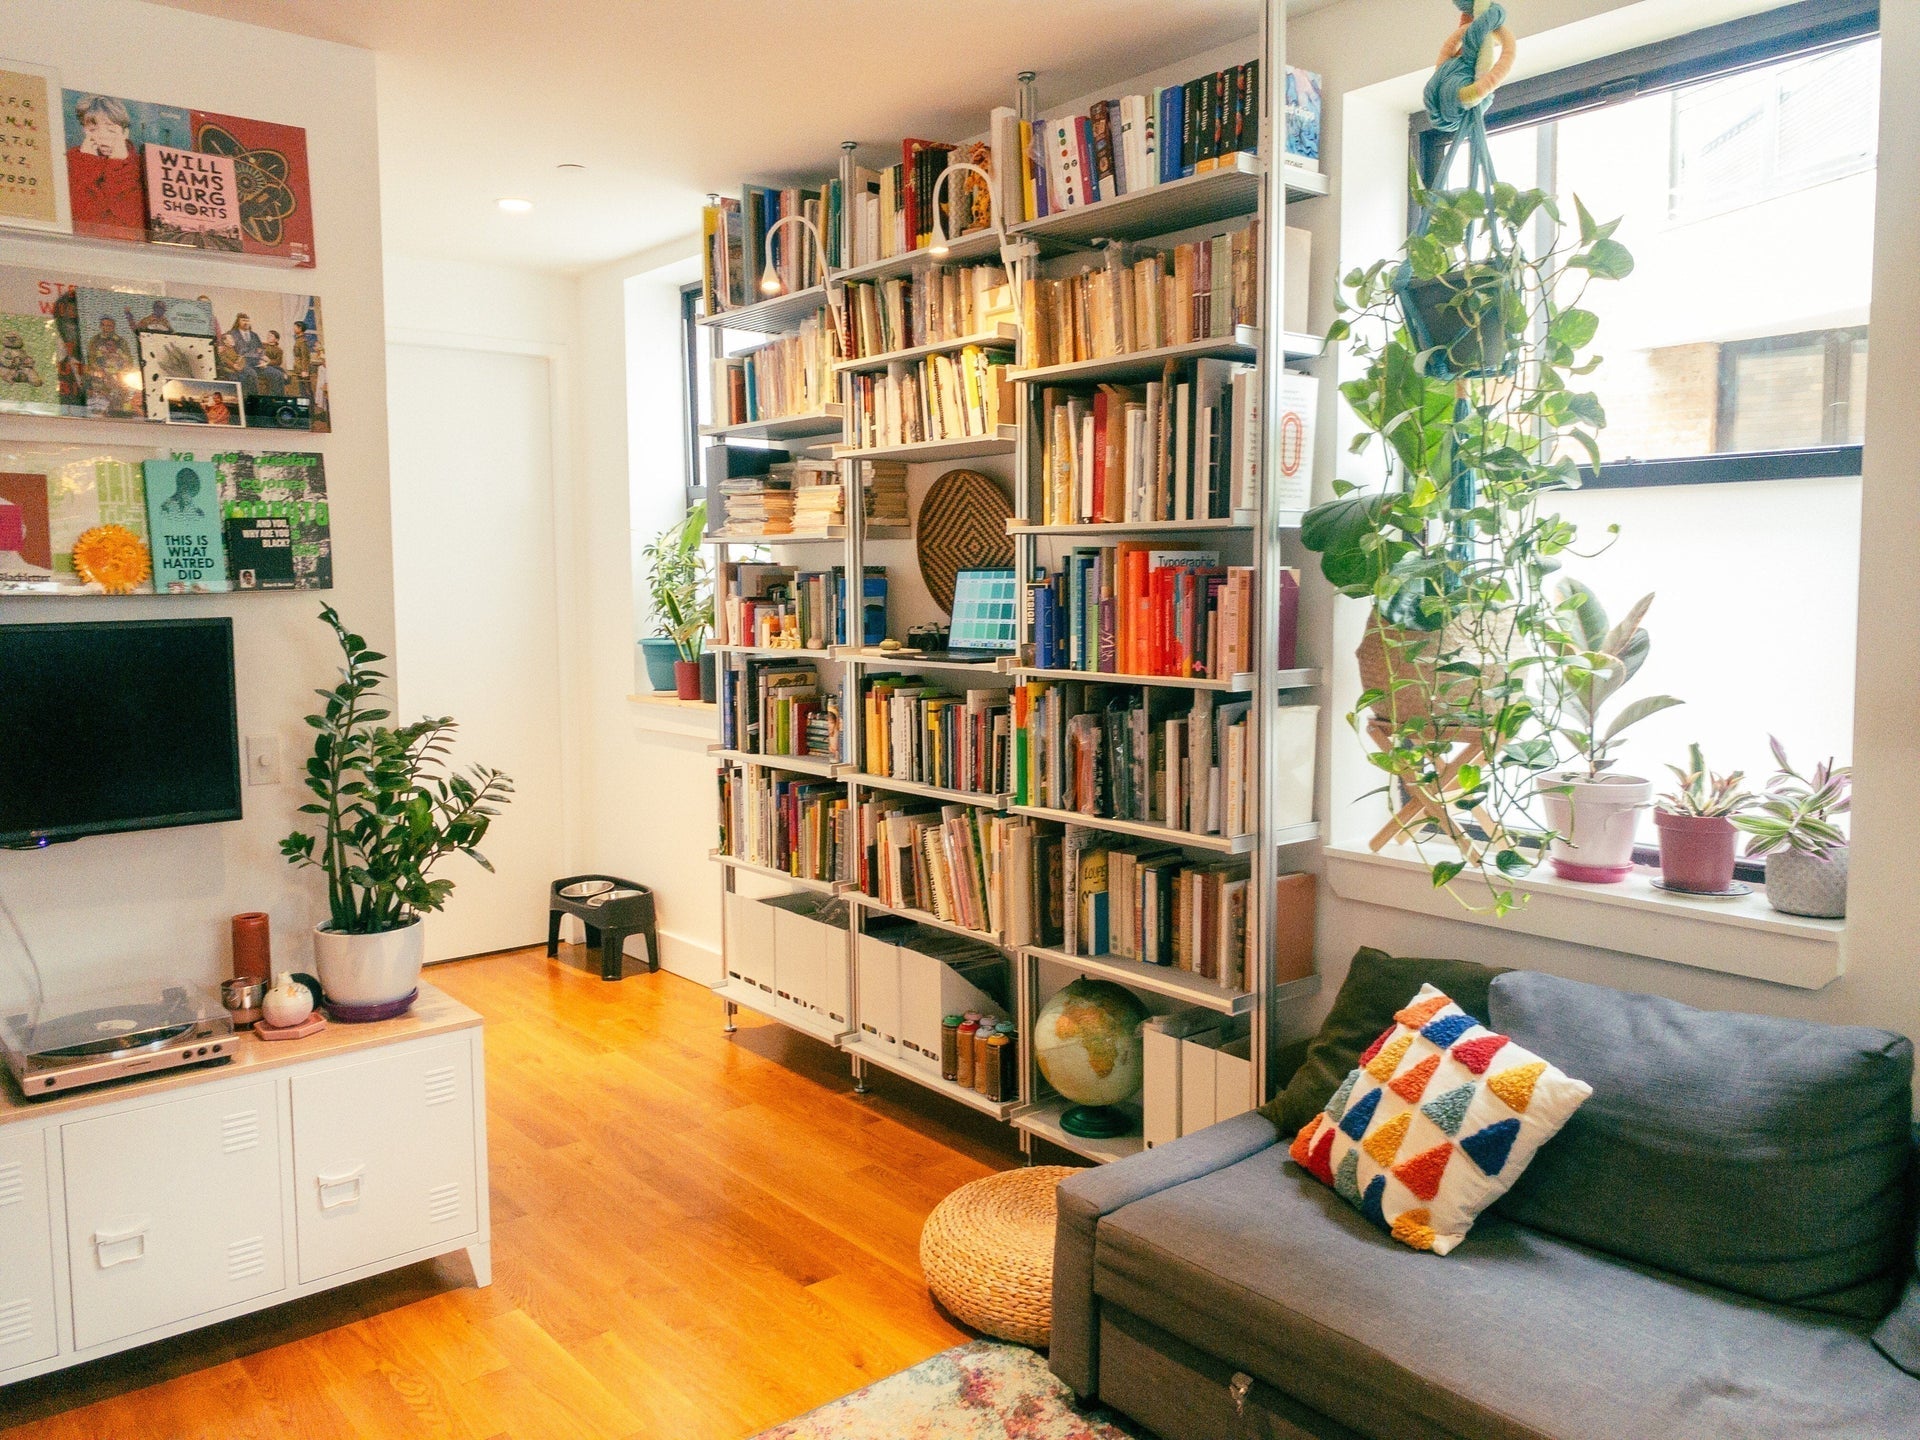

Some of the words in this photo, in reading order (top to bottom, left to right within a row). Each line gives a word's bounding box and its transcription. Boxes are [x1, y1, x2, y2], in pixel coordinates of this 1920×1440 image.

[159, 150, 222, 174] WILL
[161, 166, 224, 191] IAMS
[162, 182, 226, 206] BURG
[164, 200, 227, 219] SHORTS
[164, 535, 192, 546] THIS
[197, 535, 208, 546] IS
[168, 547, 207, 557] WHAT
[163, 558, 215, 569] HATRED
[178, 570, 202, 580] DID
[1027, 589, 1035, 625] DESIGN
